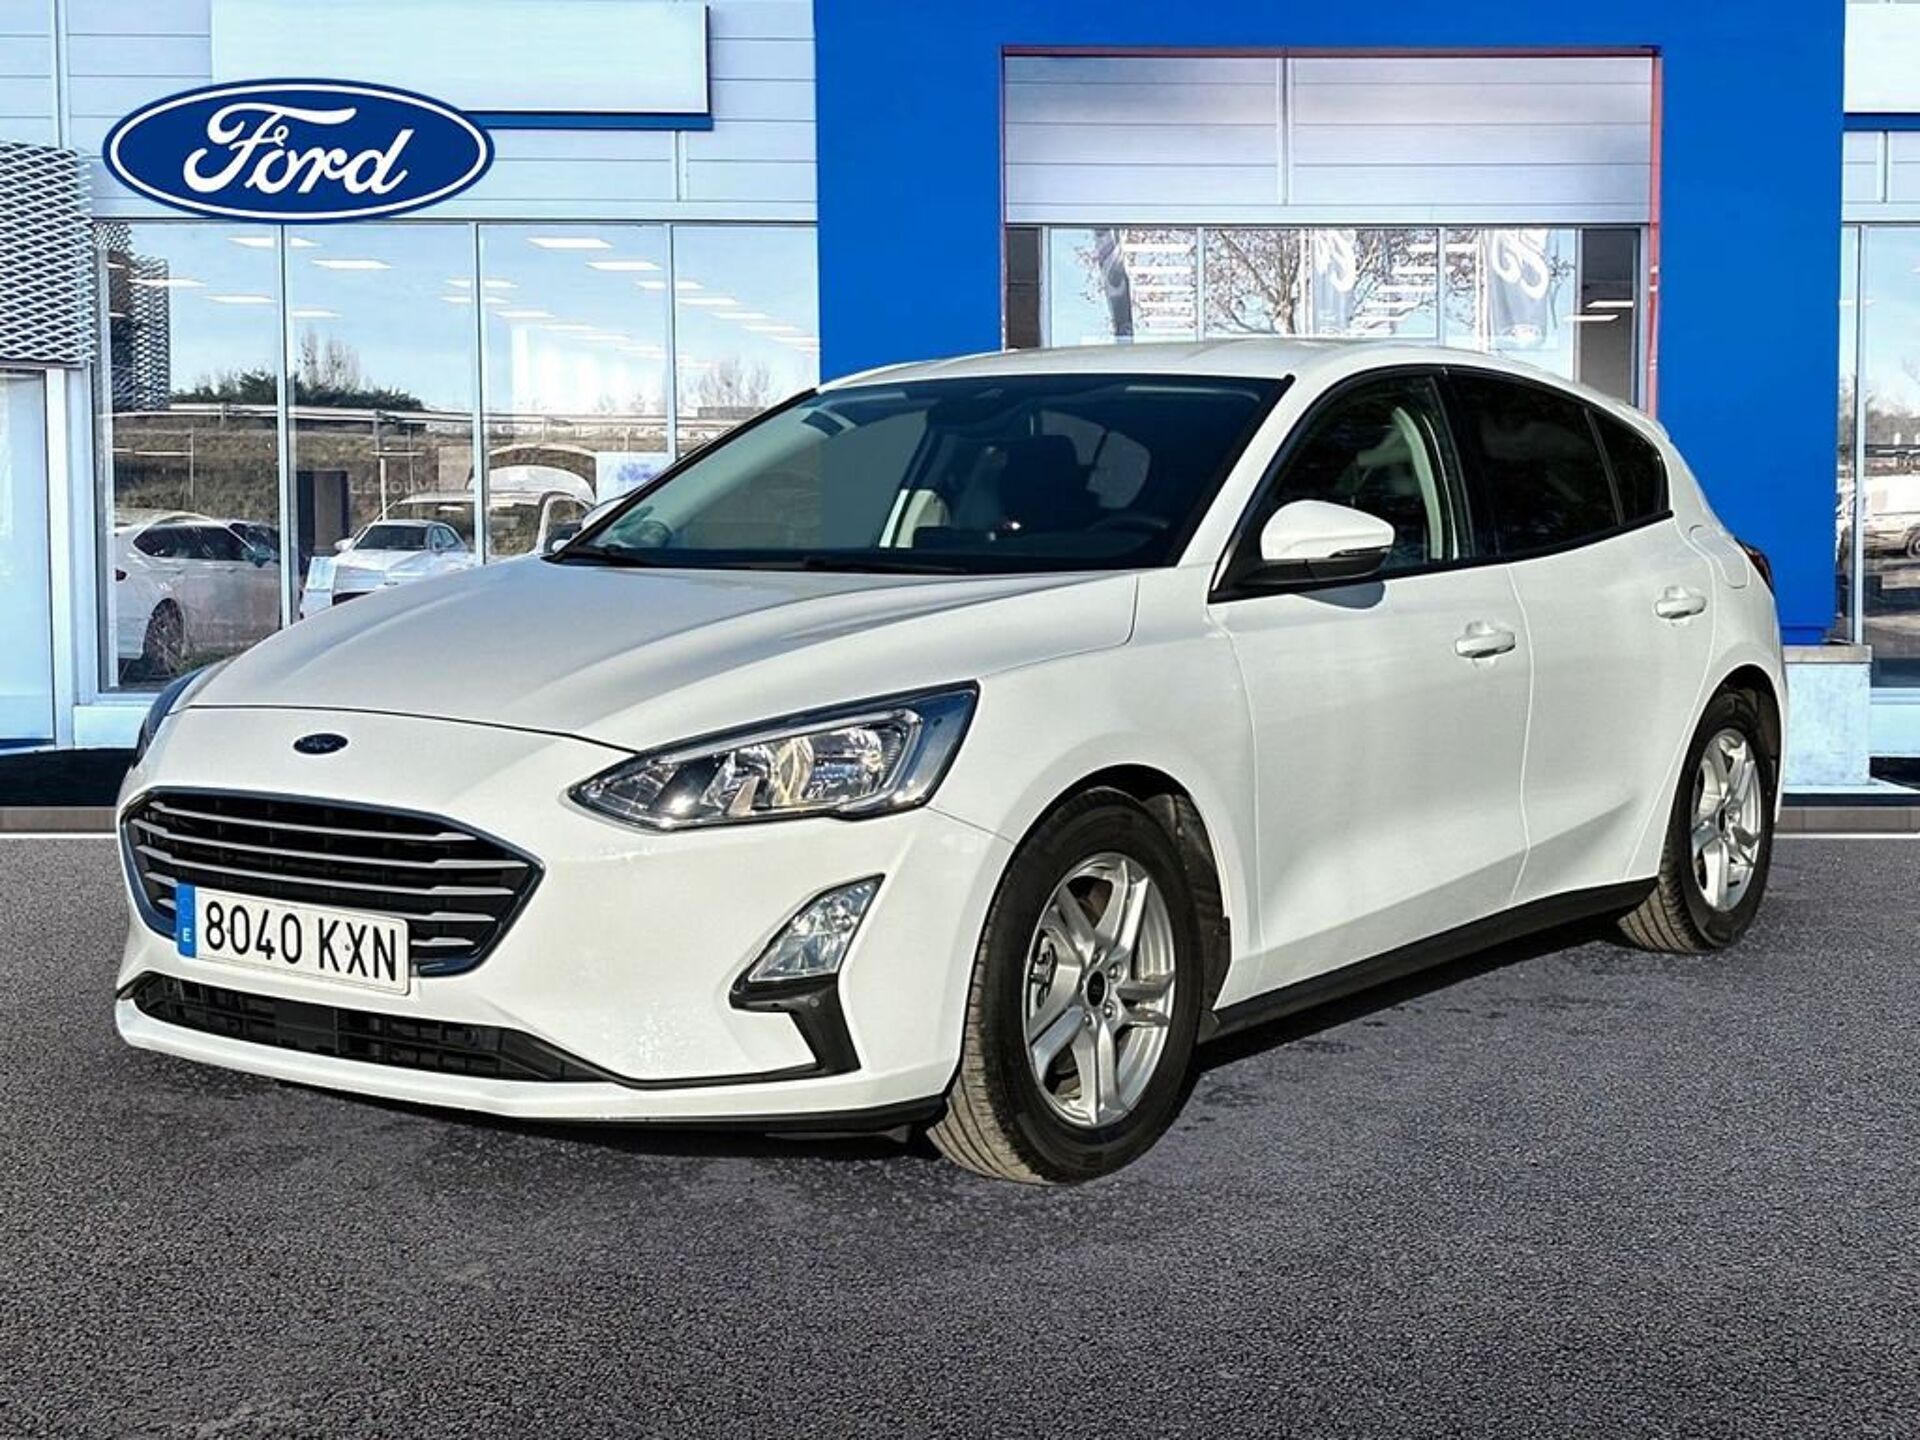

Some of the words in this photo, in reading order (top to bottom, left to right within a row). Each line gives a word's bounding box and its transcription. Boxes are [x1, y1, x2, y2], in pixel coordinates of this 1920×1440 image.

[183, 102, 414, 194] Ford
[182, 927, 192, 942] E
[205, 901, 303, 964] 8040
[318, 917, 396, 982] KXN
